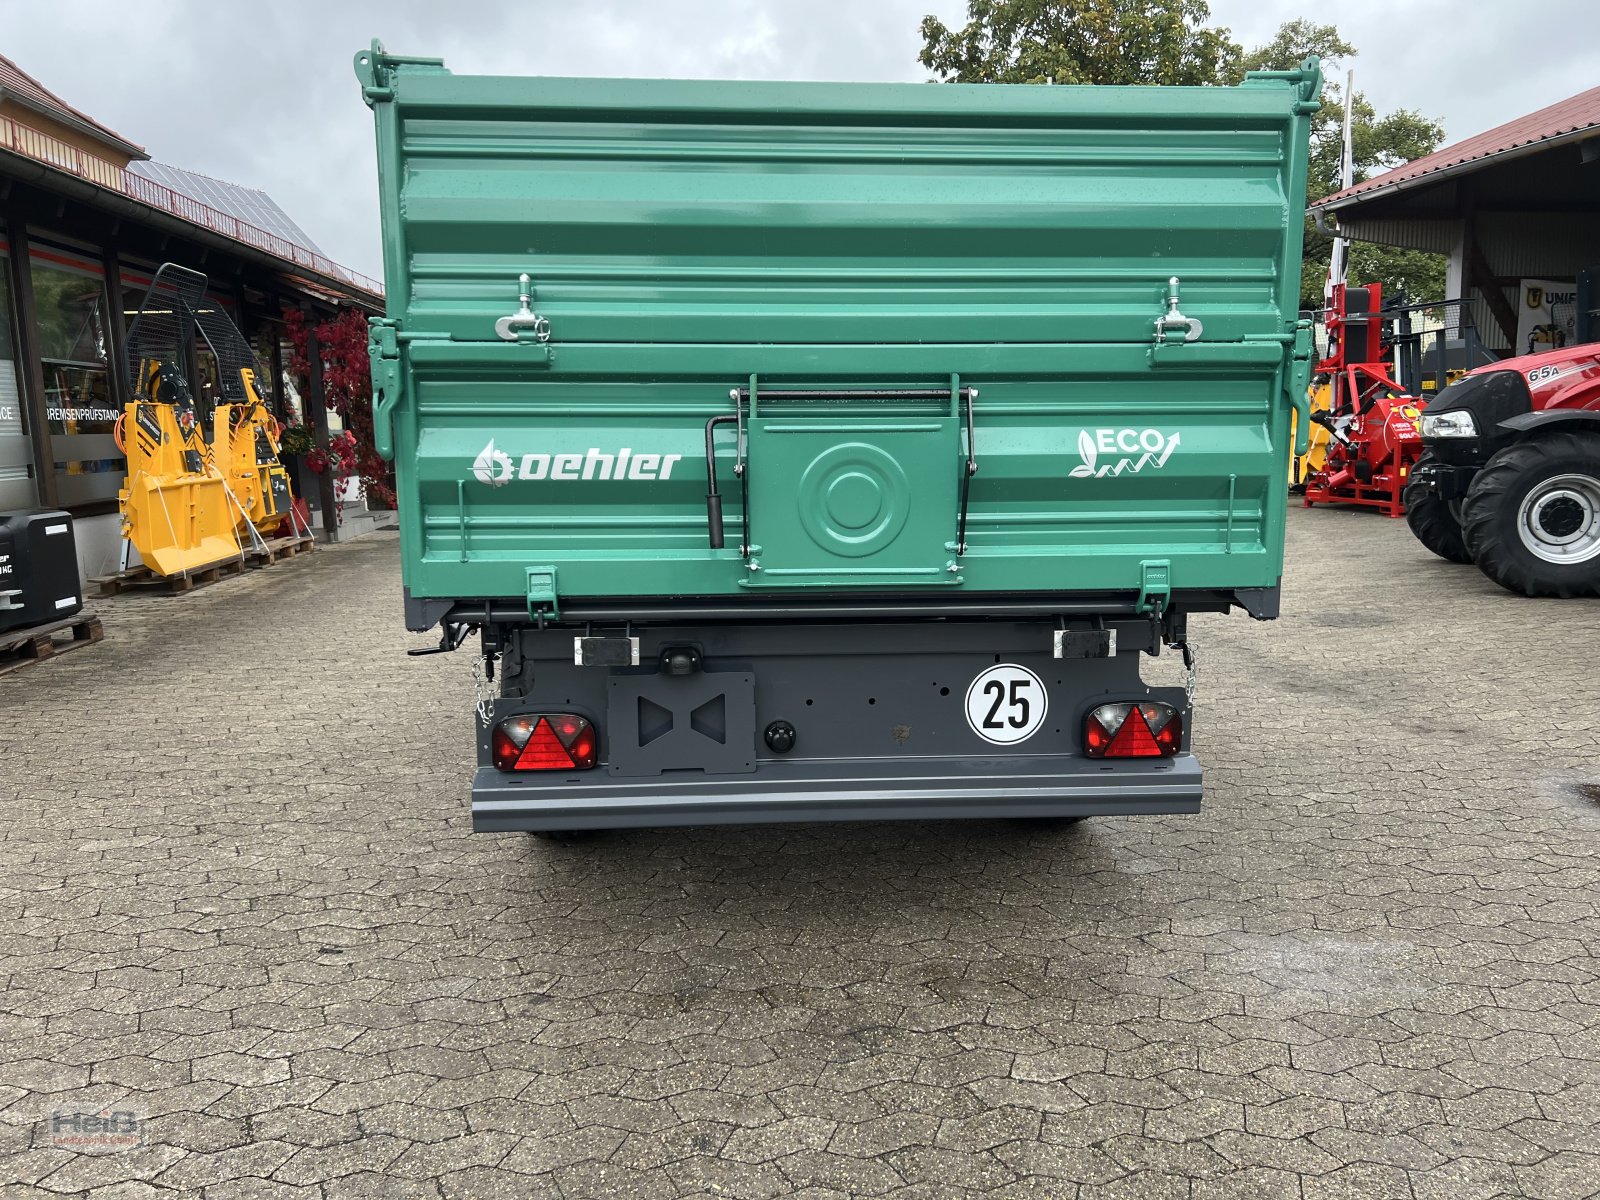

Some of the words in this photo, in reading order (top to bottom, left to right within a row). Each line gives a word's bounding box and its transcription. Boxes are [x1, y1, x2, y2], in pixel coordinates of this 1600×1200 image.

[1528, 366, 1559, 381] 65A
[0, 406, 13, 420] CE
[1096, 428, 1165, 453] ECO
[518, 447, 682, 481] oehler
[982, 679, 1031, 729] 25
